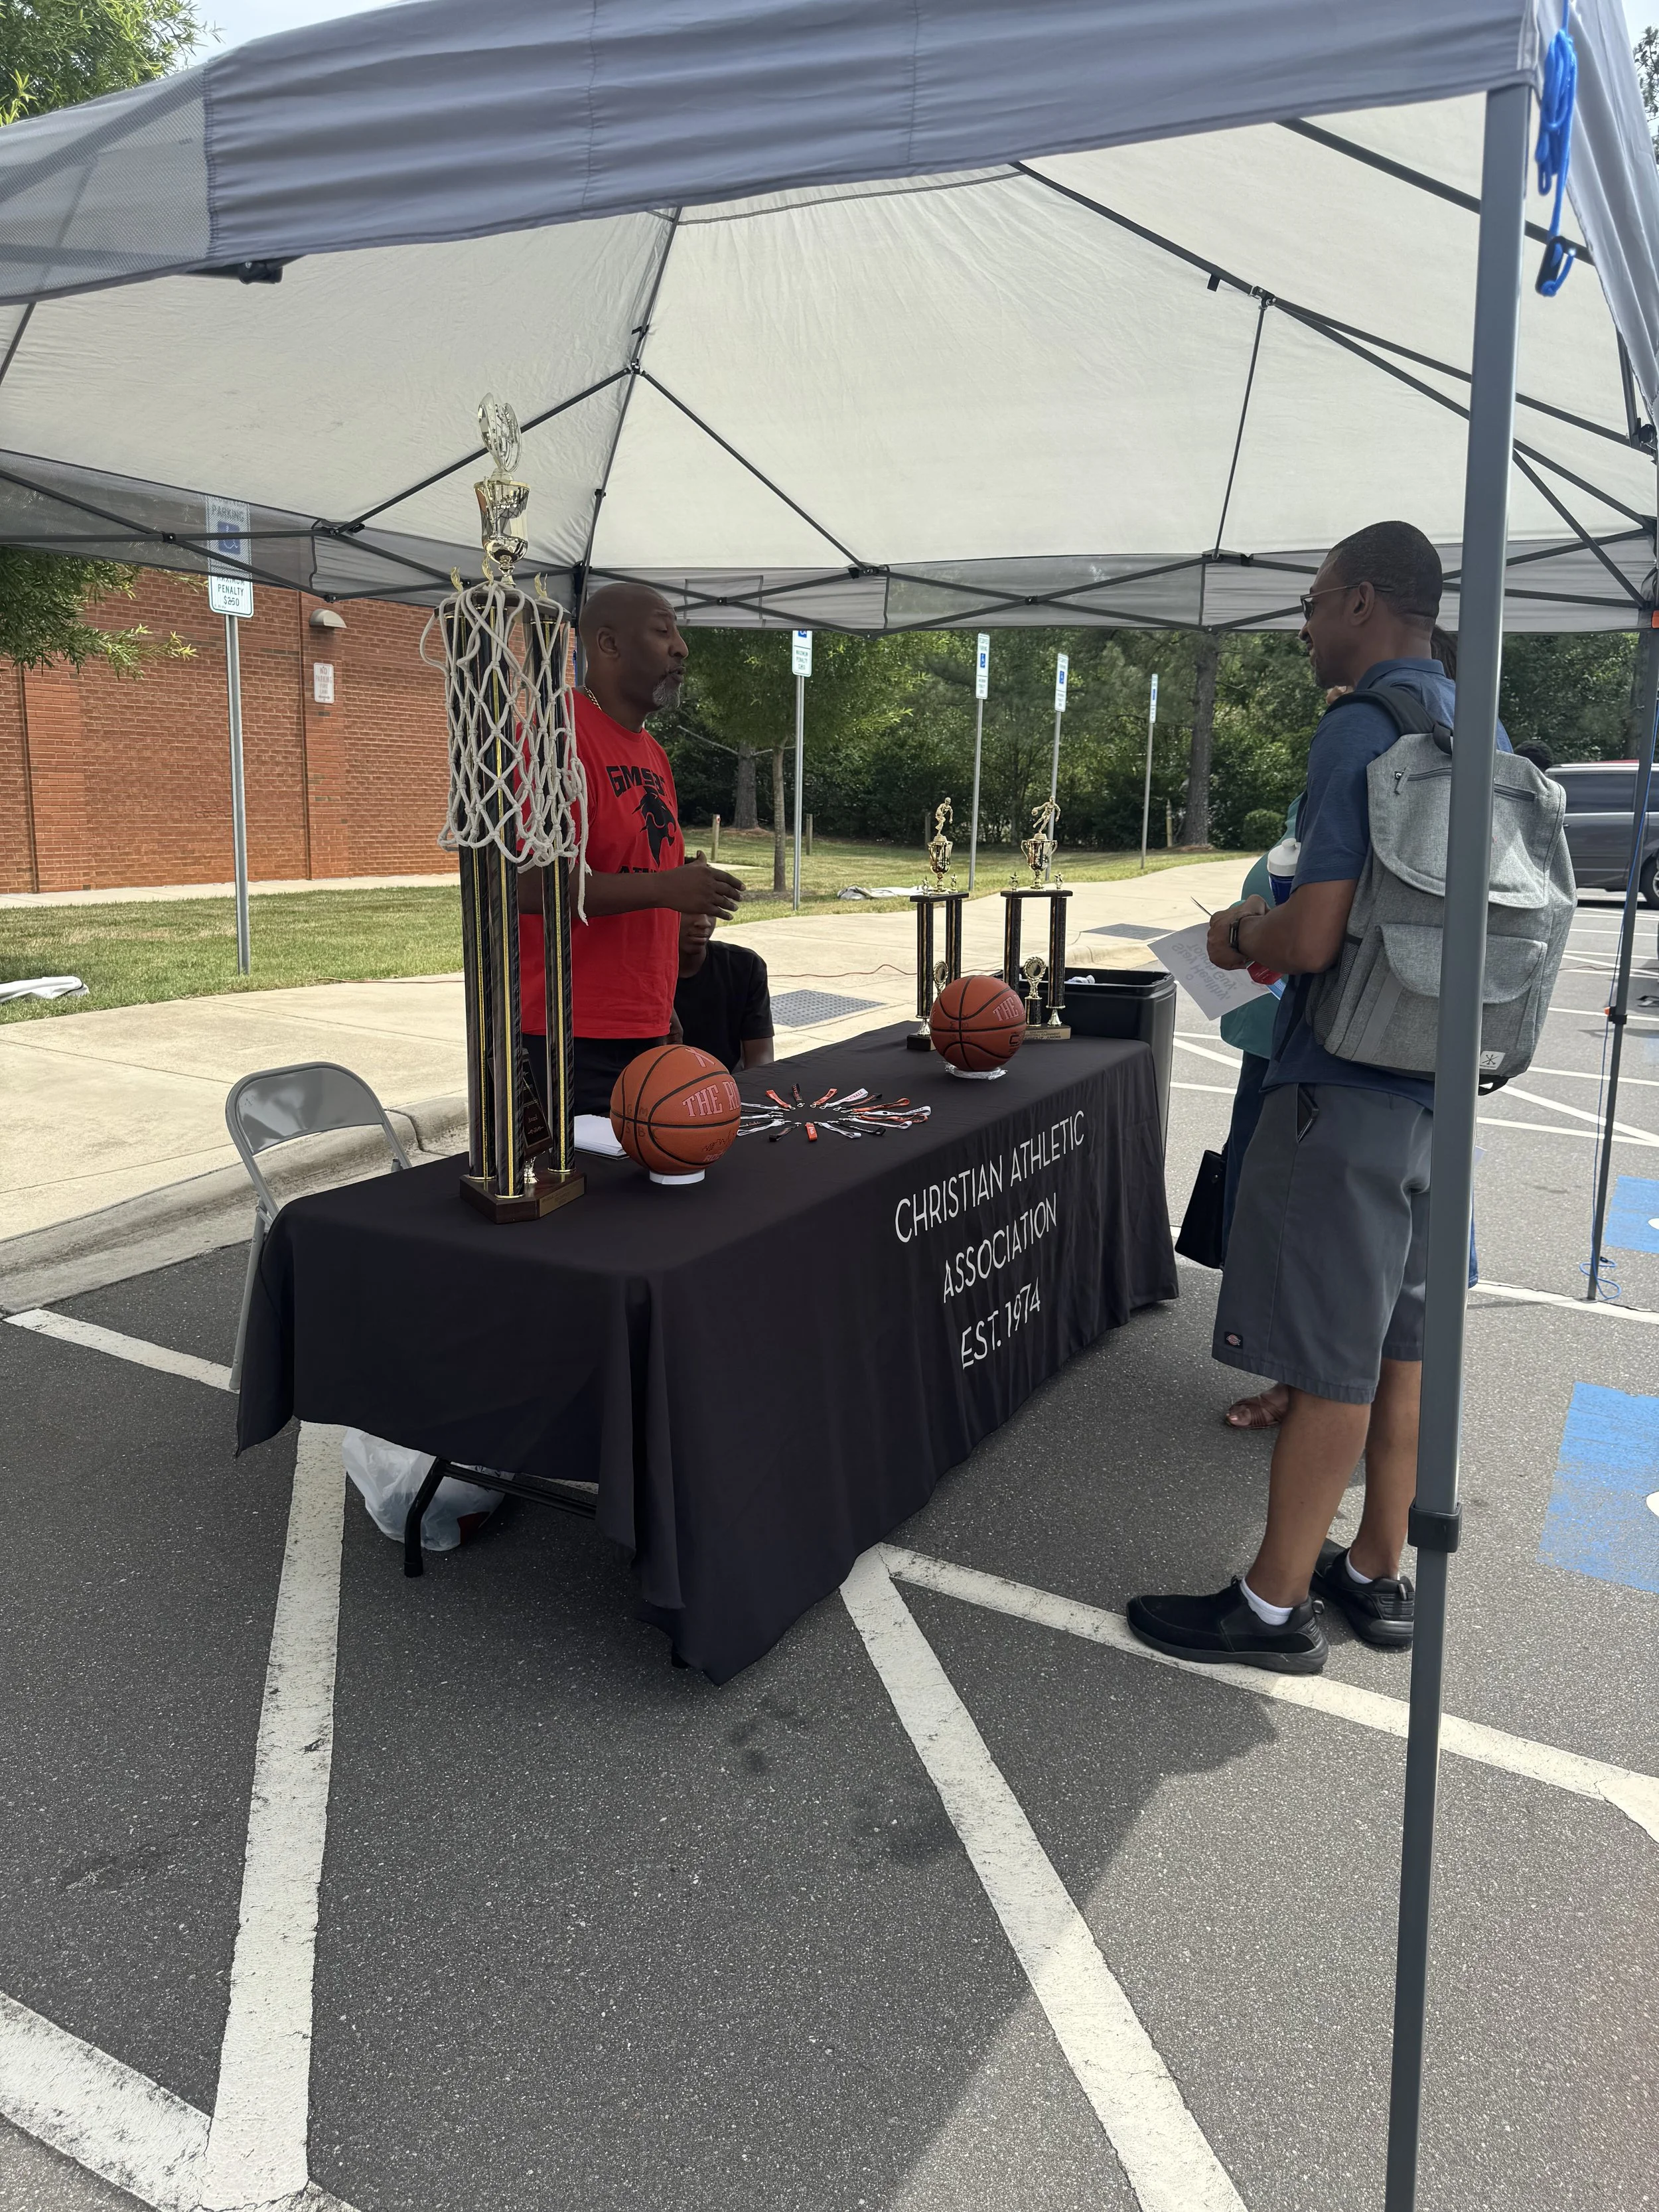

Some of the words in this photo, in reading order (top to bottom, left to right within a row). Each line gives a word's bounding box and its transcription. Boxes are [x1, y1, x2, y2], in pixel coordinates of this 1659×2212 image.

[218, 583, 244, 597] PENALTY
[224, 595, 240, 607] $250
[993, 996, 1019, 1021] THE
[682, 1084, 723, 1117] THE
[895, 1155, 1003, 1243] CHRISTIAN
[1010, 1110, 1085, 1187] ATHLETIC
[943, 1192, 1057, 1303] ASSOCIATION
[961, 1310, 1002, 1370] EST.
[1005, 1277, 1041, 1337] 1974
